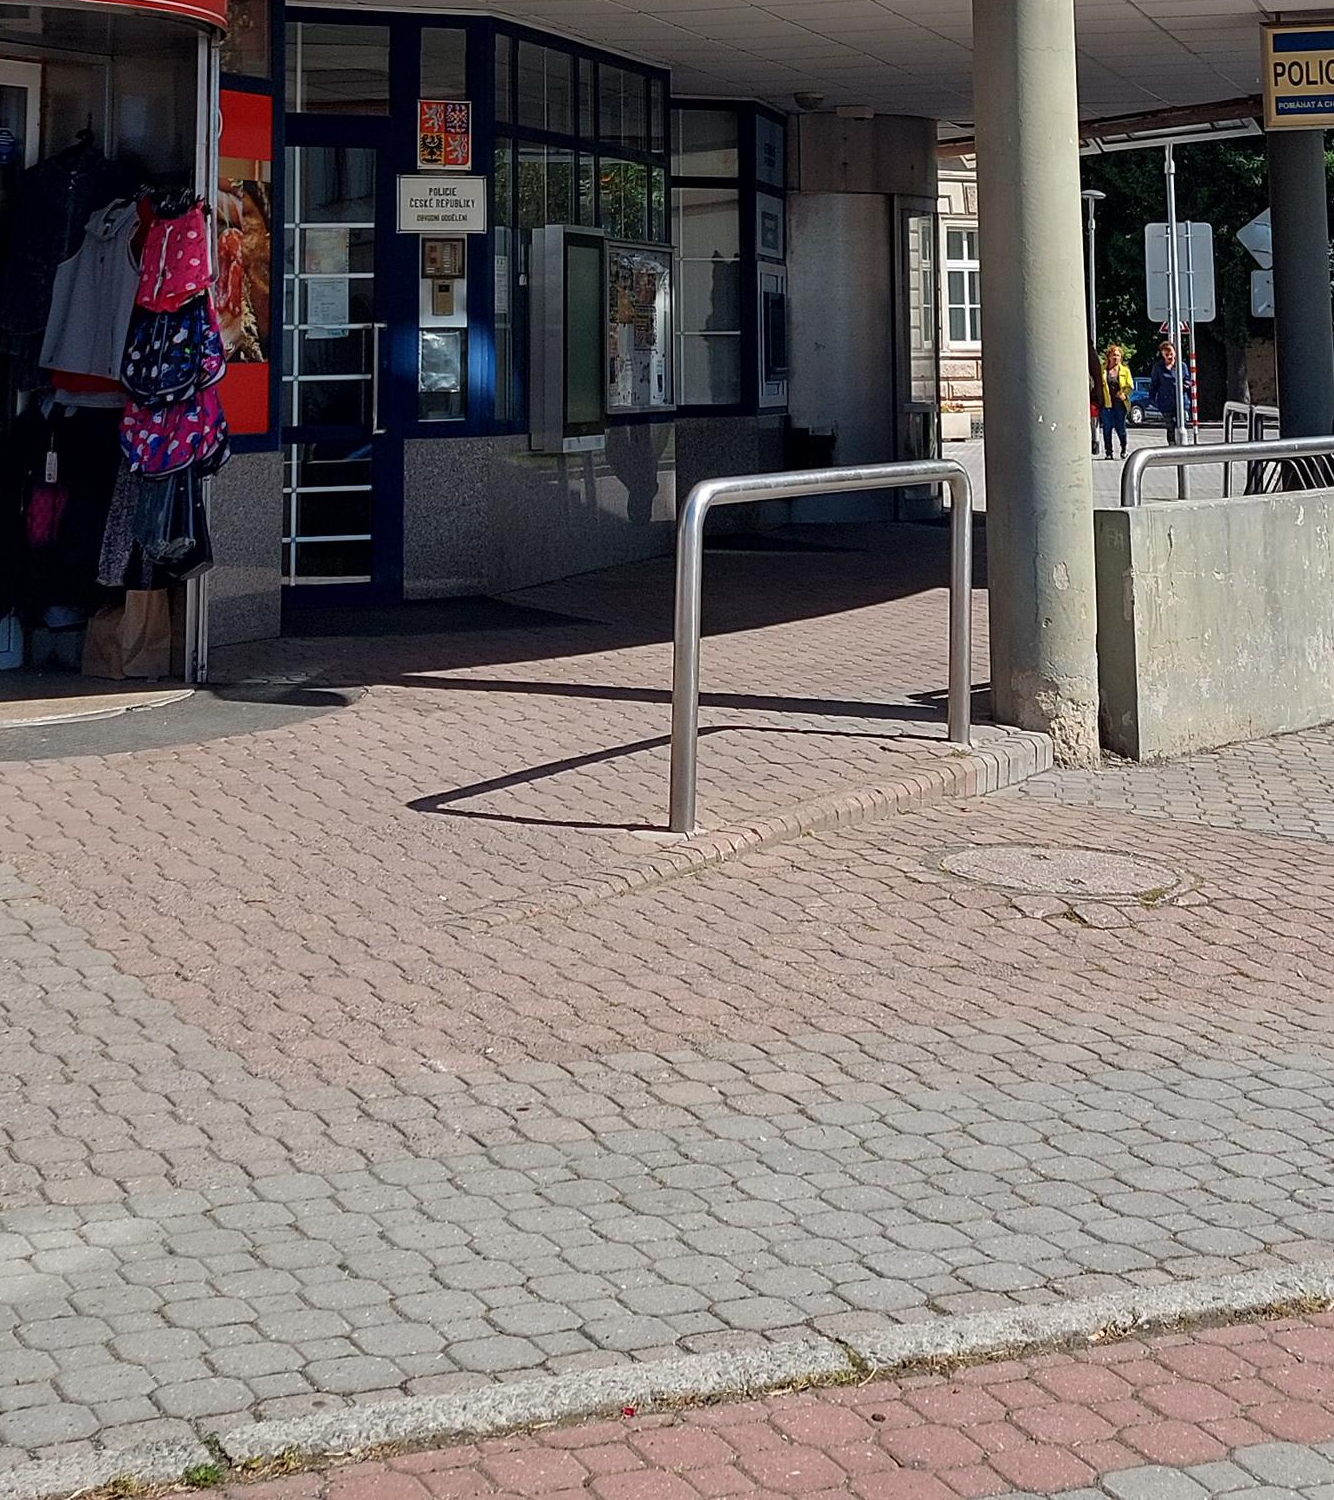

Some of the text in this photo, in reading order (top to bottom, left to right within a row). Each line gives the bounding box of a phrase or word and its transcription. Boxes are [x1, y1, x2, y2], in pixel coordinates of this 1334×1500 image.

[1278, 101, 1316, 110] POMÁHAT
[1316, 100, 1324, 108] A
[428, 187, 457, 197] POLICIE
[409, 197, 475, 209] ČESKÉ REPUBLIKY
